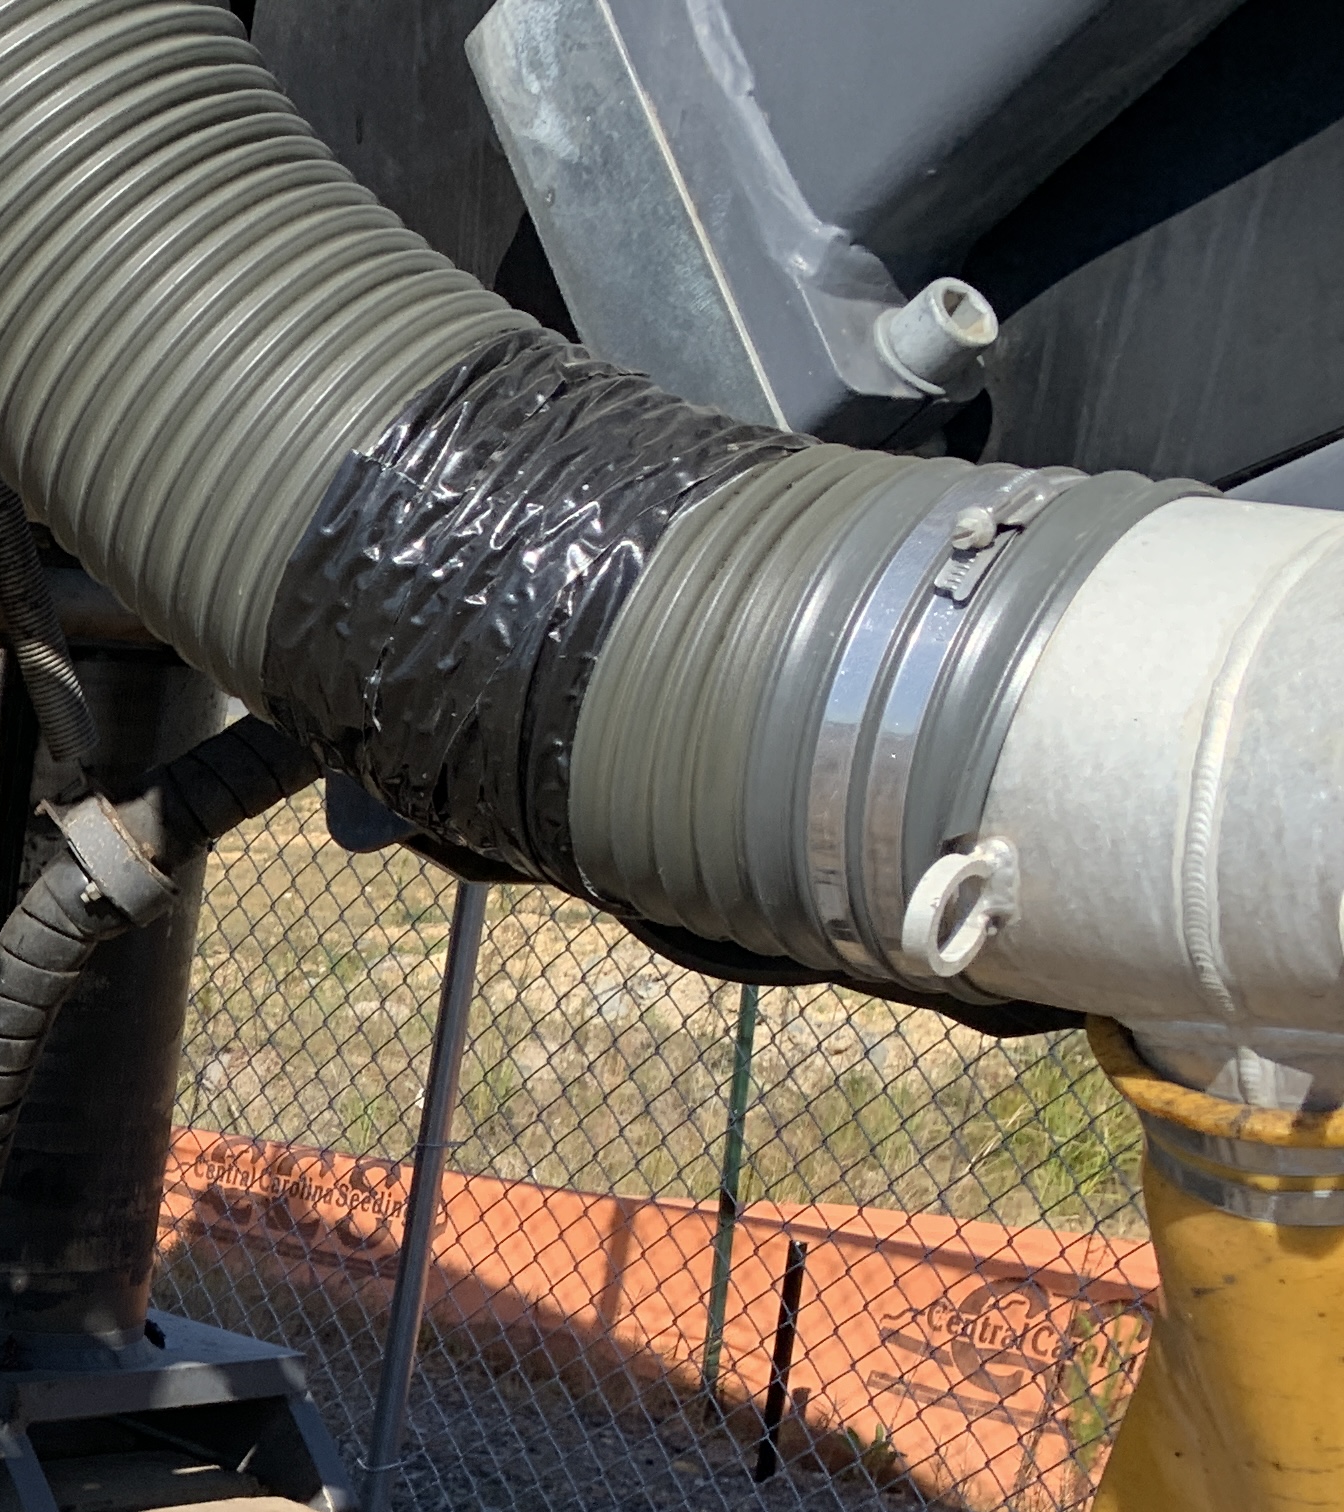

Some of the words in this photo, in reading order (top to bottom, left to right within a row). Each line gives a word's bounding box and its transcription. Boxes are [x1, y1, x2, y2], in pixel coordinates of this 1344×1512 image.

[194, 1155, 256, 1188] Central
[258, 1167, 334, 1204] Carolina
[927, 1300, 1027, 1352] Central
